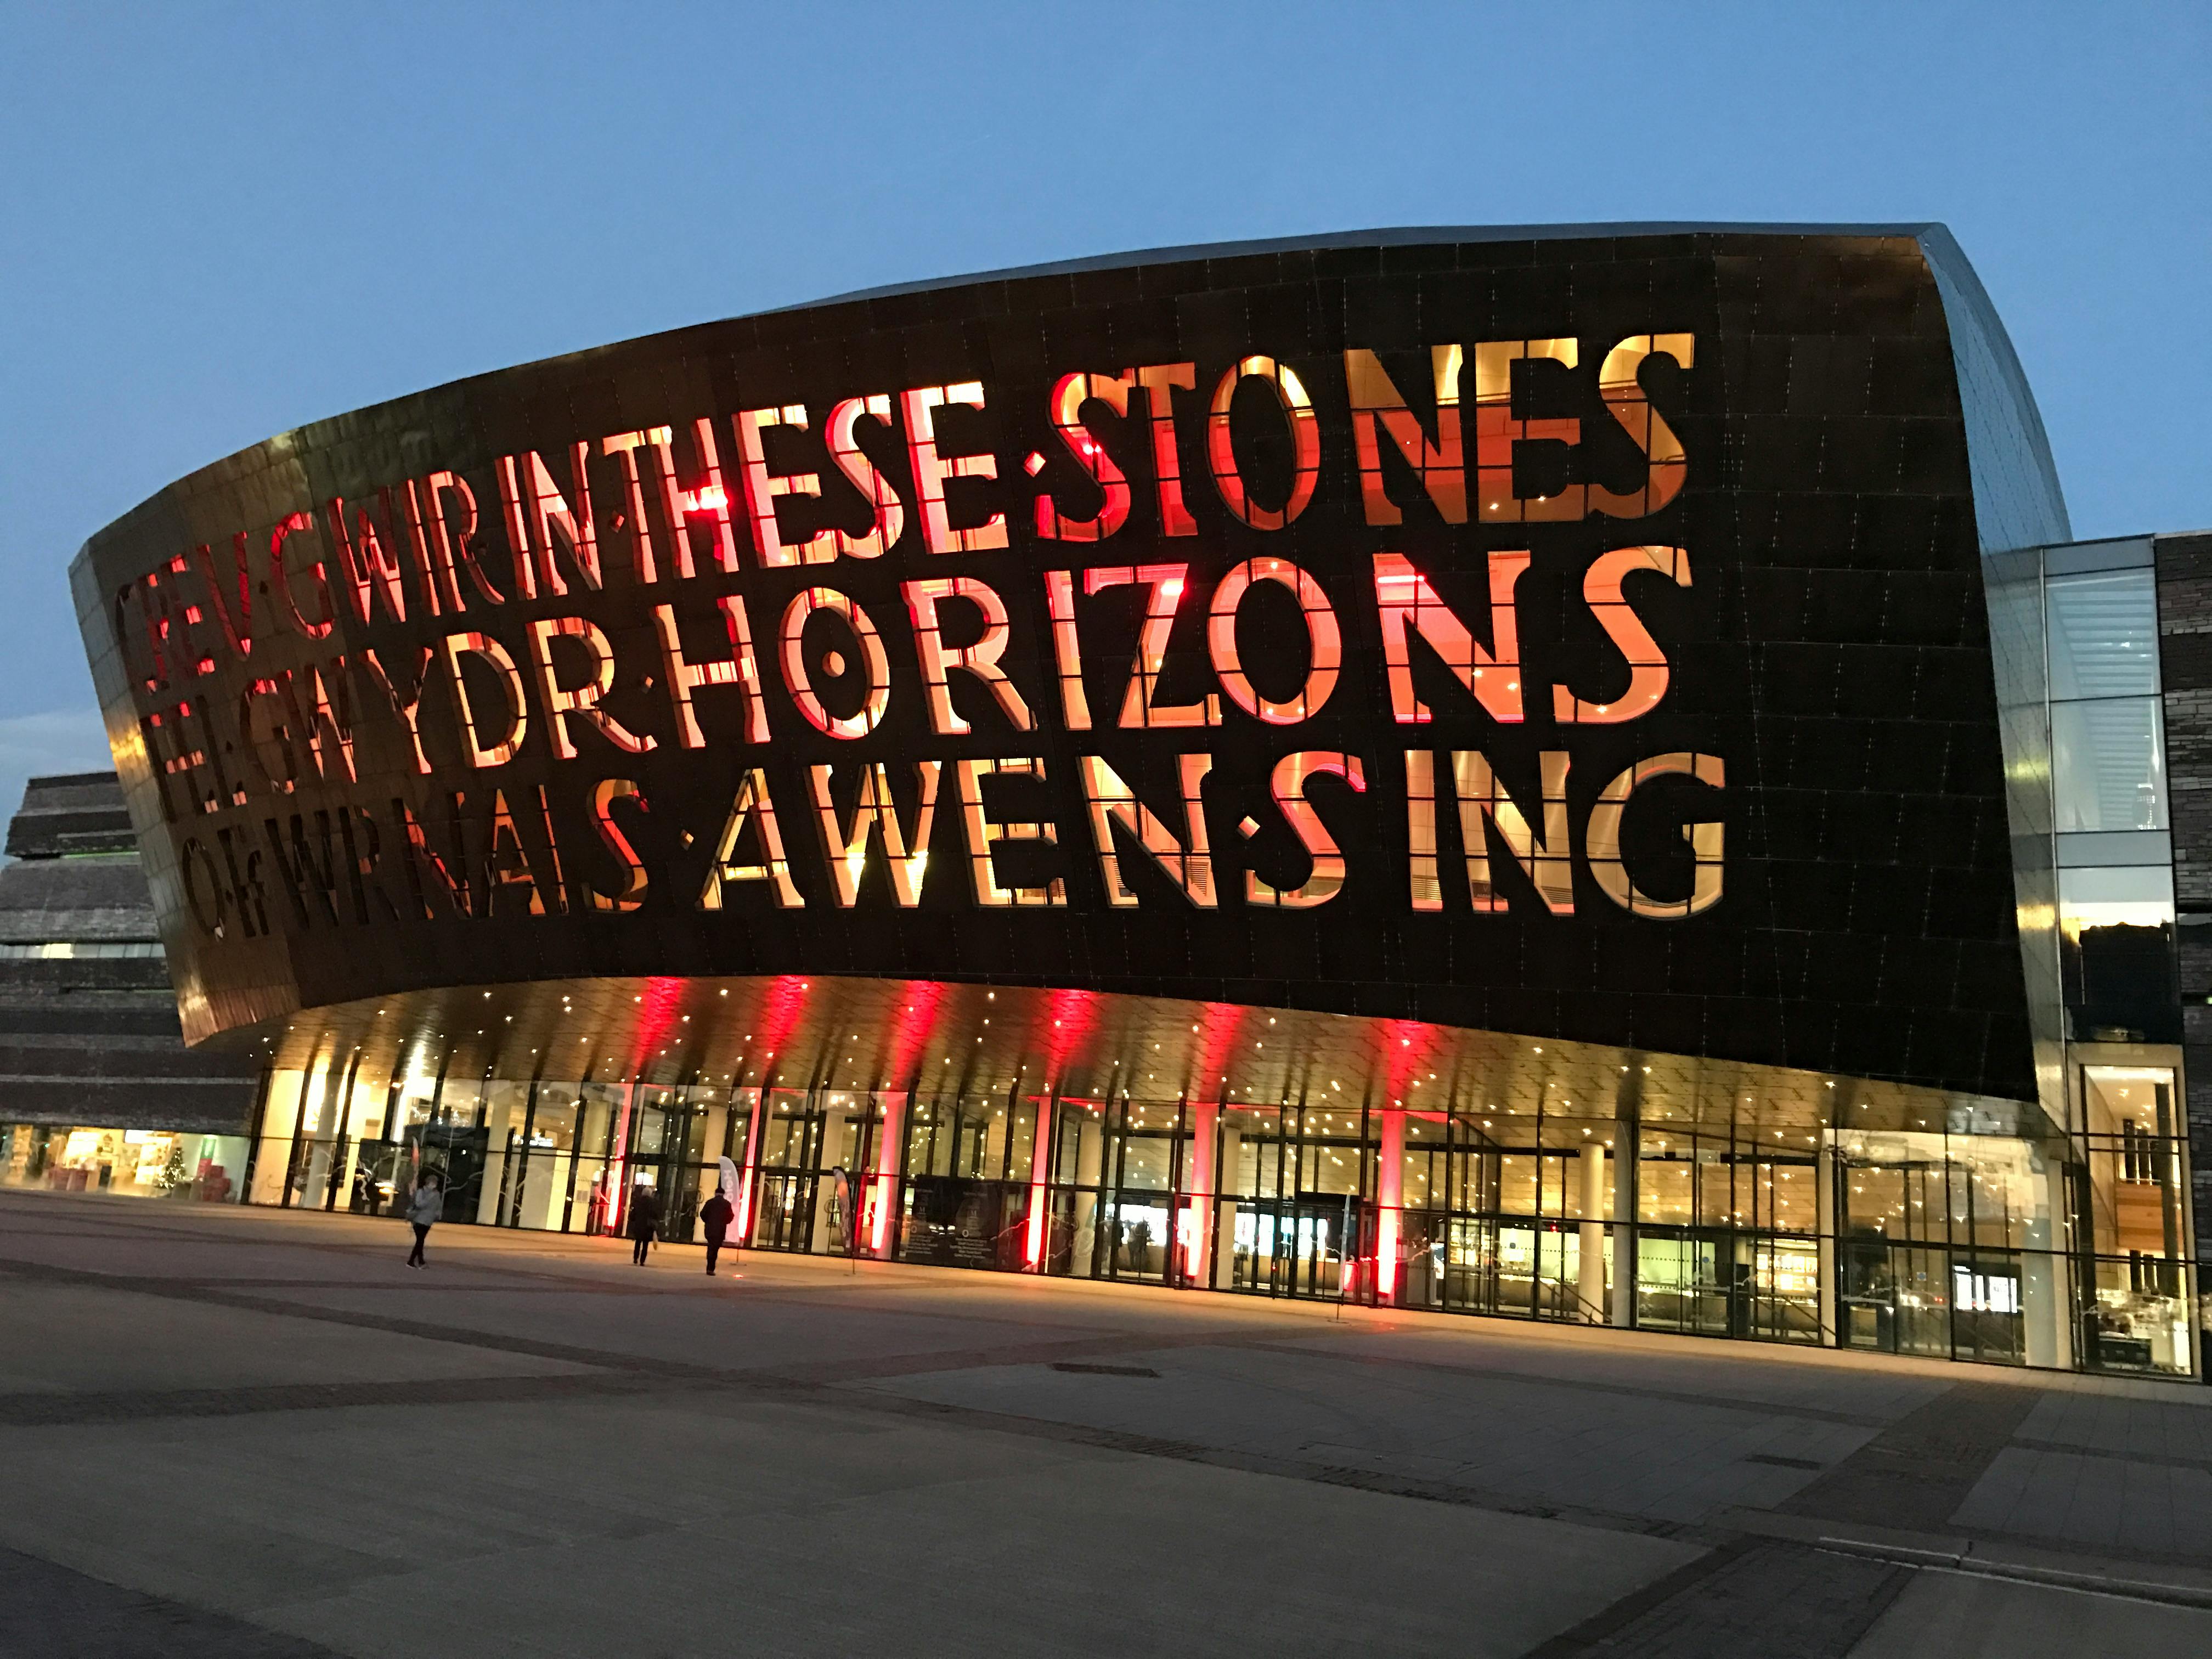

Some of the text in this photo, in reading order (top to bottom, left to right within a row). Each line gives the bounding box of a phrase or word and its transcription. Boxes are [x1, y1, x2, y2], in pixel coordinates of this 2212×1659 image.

[270, 470, 505, 640] GWIR
[495, 441, 603, 600] IN
[602, 381, 1010, 584] THESE
[1034, 332, 1695, 543] STONES
[238, 617, 657, 794] GWYDR
[650, 545, 1692, 749] HORIZONS
[695, 753, 1218, 910] AWEN
[1244, 749, 1725, 920] SING
